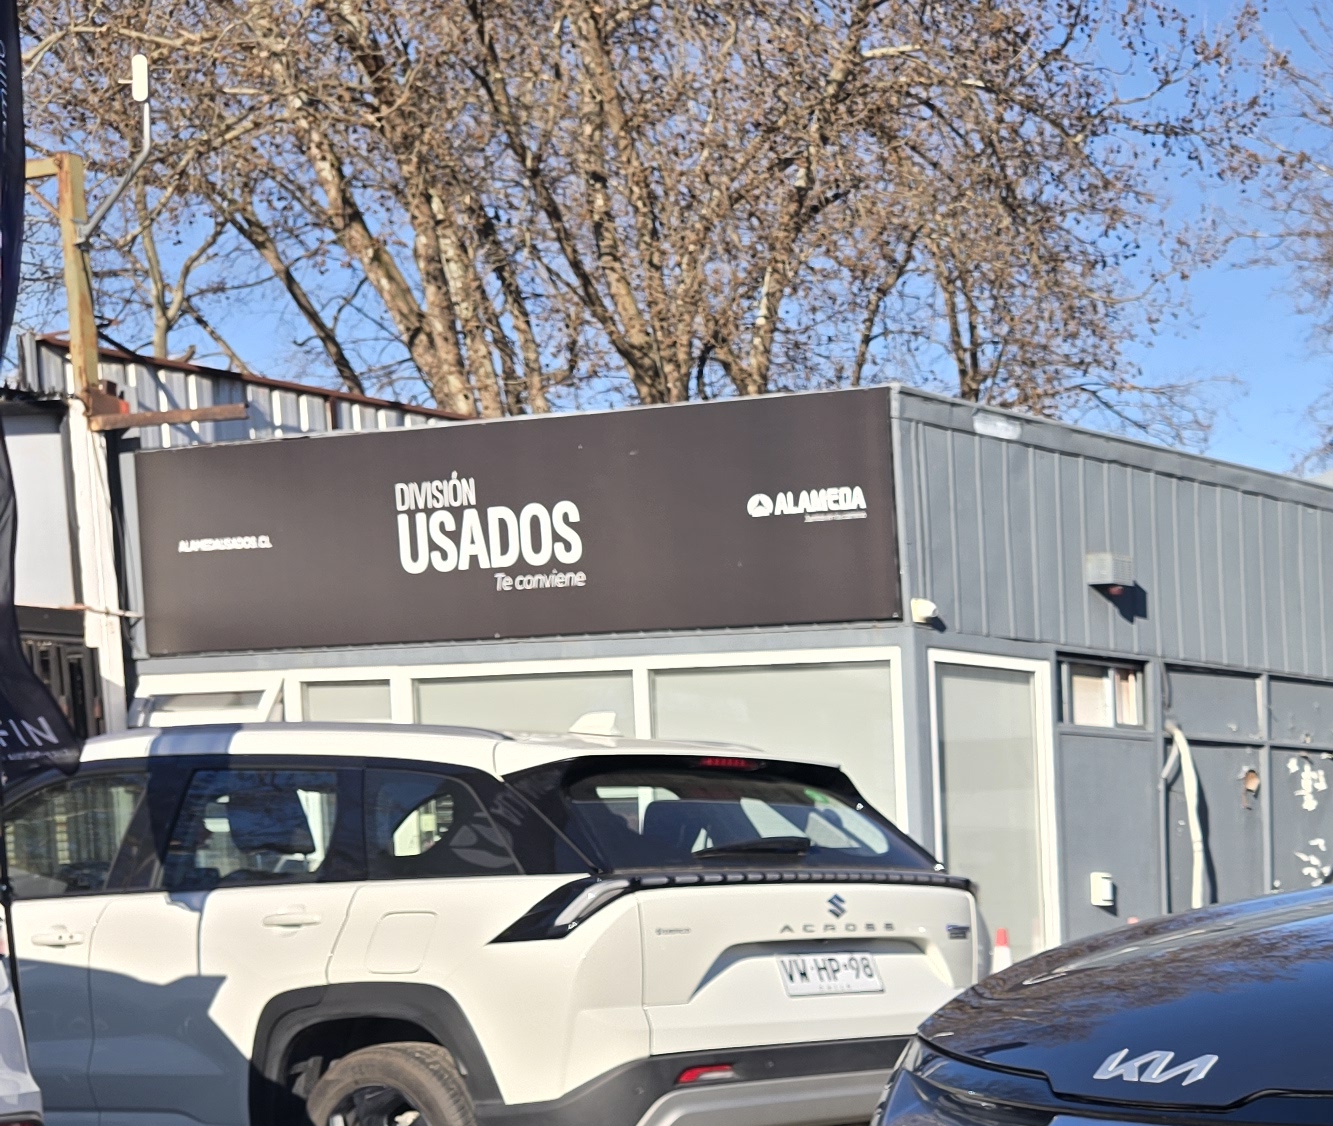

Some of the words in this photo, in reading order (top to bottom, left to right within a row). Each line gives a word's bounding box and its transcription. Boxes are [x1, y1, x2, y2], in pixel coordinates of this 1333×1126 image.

[394, 470, 477, 511] DIVISIÓN
[774, 486, 867, 515] ALAMEDA
[397, 500, 583, 574] USADOS
[494, 572, 514, 591] Te
[514, 568, 587, 590] conviene
[779, 922, 896, 934] ACROSS
[1093, 1048, 1219, 1086] KIA
